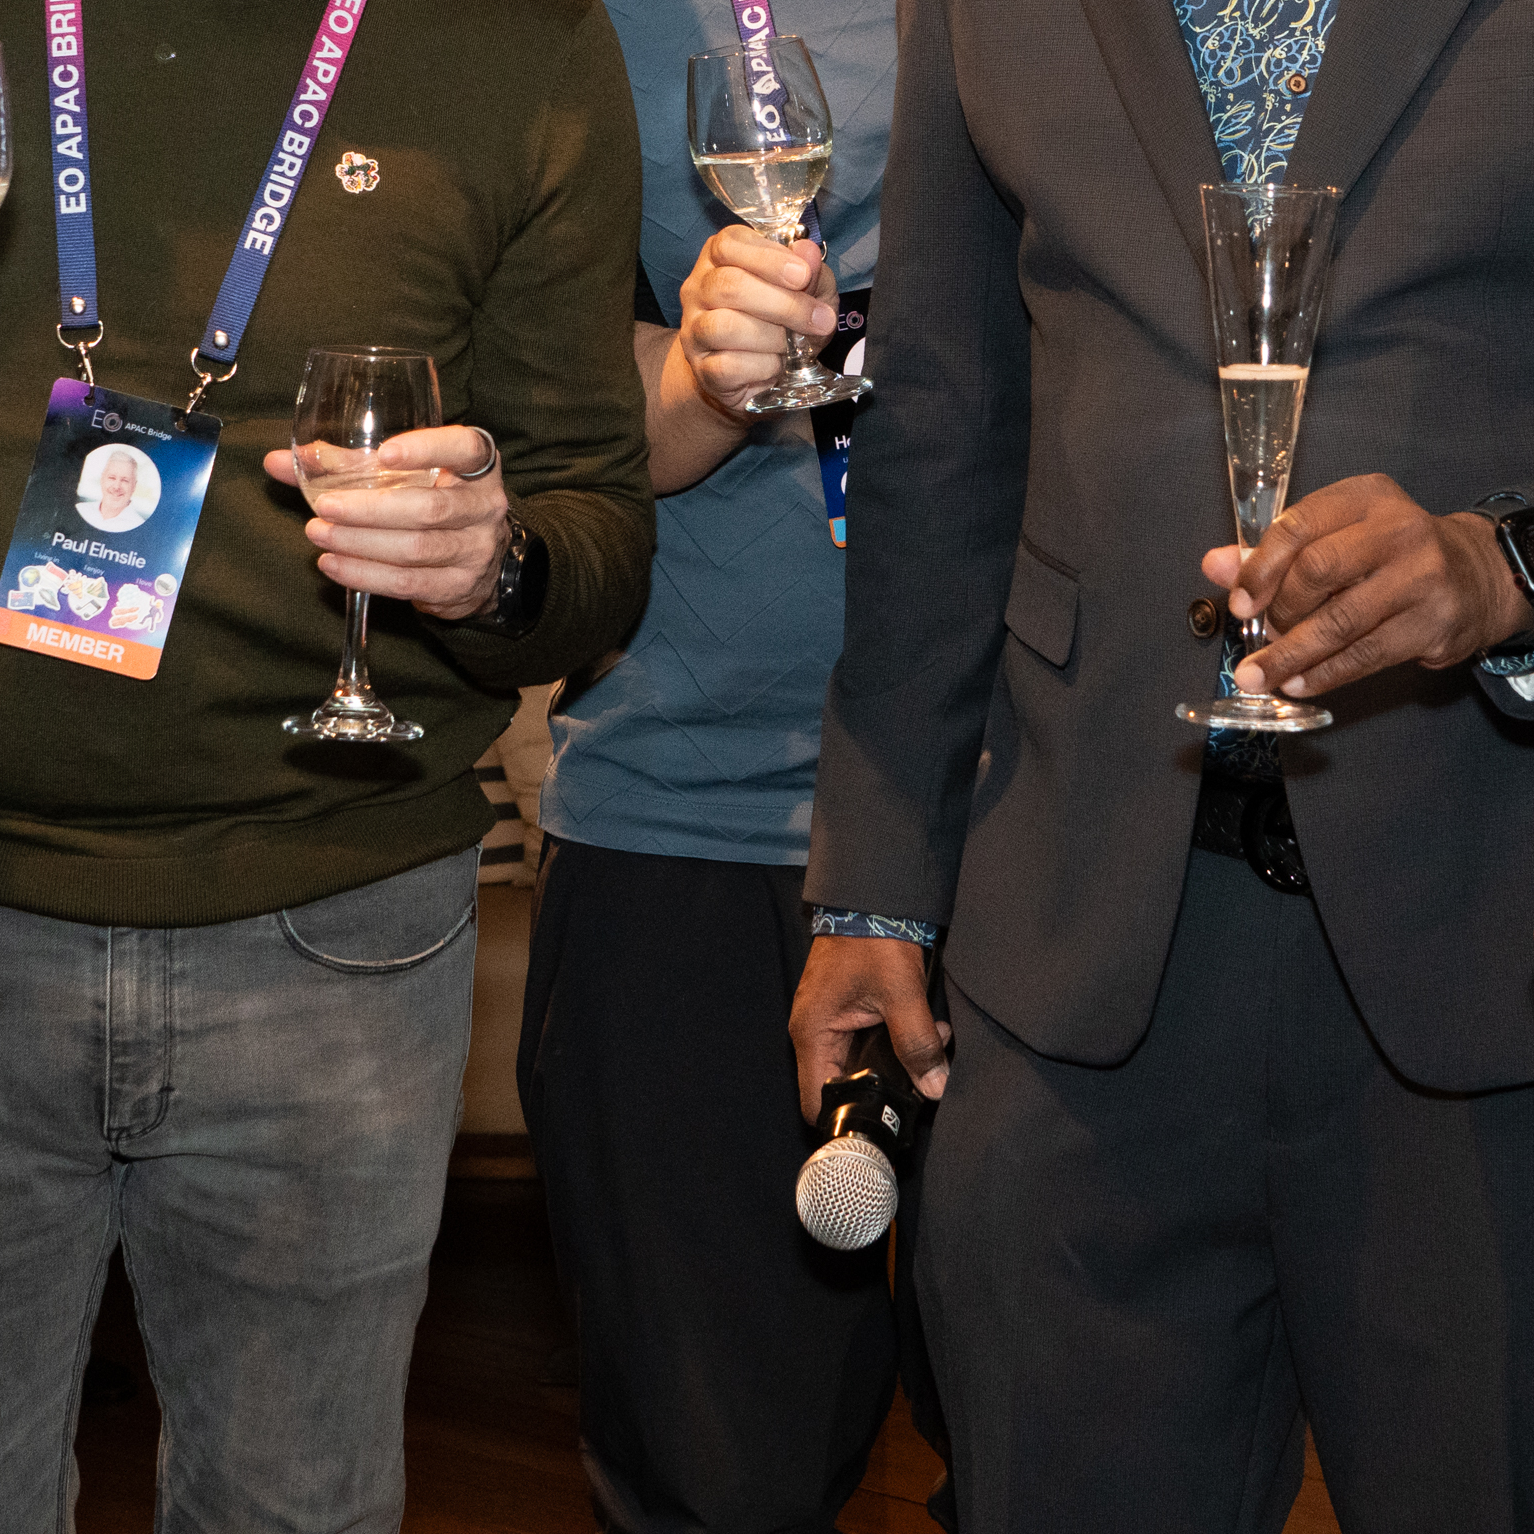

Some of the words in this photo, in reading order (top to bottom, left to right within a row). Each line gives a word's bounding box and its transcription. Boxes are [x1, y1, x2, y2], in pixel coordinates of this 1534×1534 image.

[291, 34, 344, 130] APAC
[51, 63, 85, 160] APAC
[58, 167, 88, 216] EO
[243, 128, 312, 256] BRIDGE
[124, 421, 149, 437] APAC
[147, 426, 173, 442] Bridge
[52, 531, 88, 555] Paul
[88, 541, 148, 570] Elmslie
[26, 621, 126, 664] MEMBER
